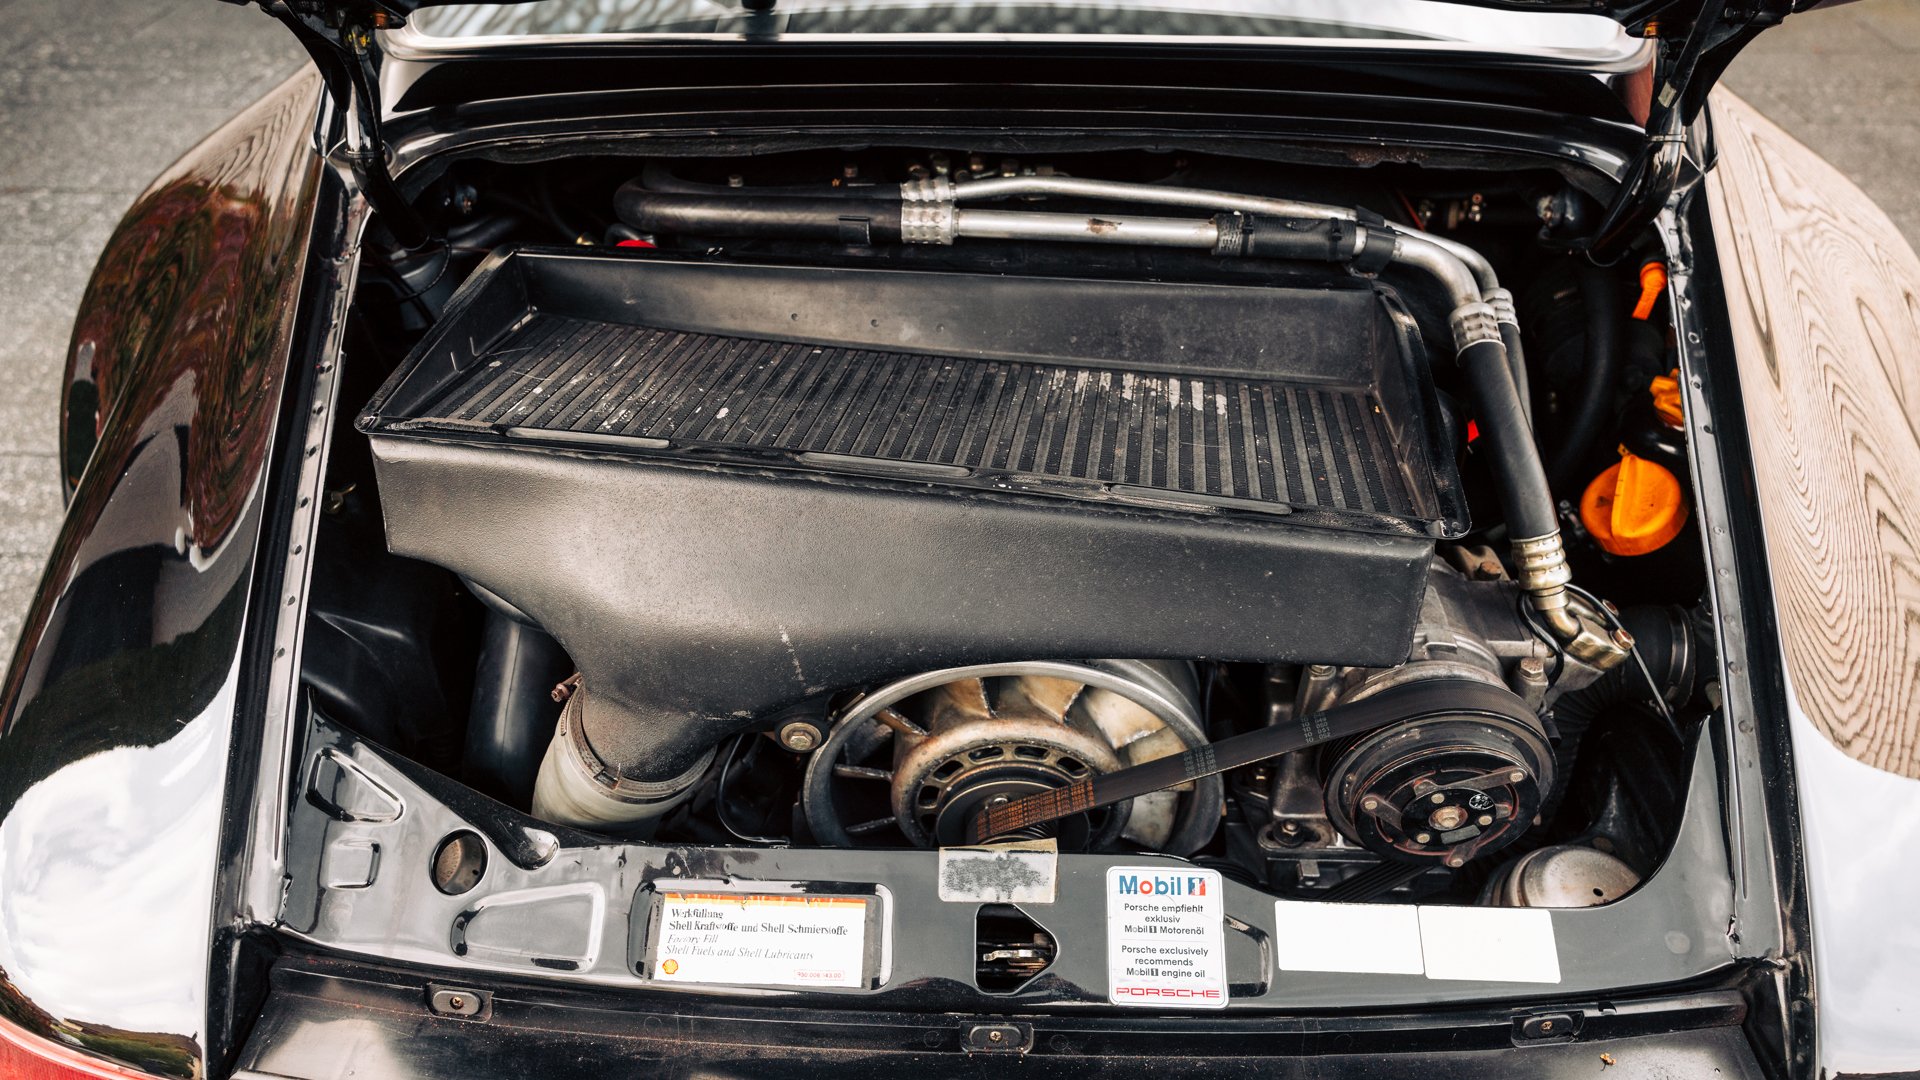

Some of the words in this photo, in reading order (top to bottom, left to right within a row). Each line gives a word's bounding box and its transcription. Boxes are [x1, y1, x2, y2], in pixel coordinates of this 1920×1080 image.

[1119, 875, 1181, 896] Mobil
[1189, 877, 1205, 896] 1
[1124, 903, 1159, 912] Porsche
[1162, 904, 1203, 914] empfiehlt
[1145, 915, 1181, 923] exklusiv
[669, 920, 693, 931] Shell
[741, 923, 759, 933] und
[761, 922, 785, 934] Shell
[787, 924, 848, 936] Schmierstoffe
[1124, 925, 1148, 934] Mobil
[1160, 926, 1205, 935] Motorenöl
[703, 934, 719, 944] Fill
[665, 945, 690, 955] Shell
[691, 945, 716, 956] Fuels
[717, 947, 737, 957] and
[738, 946, 763, 958] Shell
[764, 948, 814, 960] Lubricants
[1121, 945, 1157, 954] Porsche
[1159, 947, 1209, 957] exclusively
[1135, 958, 1194, 966] recommends
[1126, 968, 1150, 976] Mobil
[1161, 970, 1192, 978] engine
[1194, 969, 1205, 978] oil
[1116, 987, 1220, 998] PORSCHE
